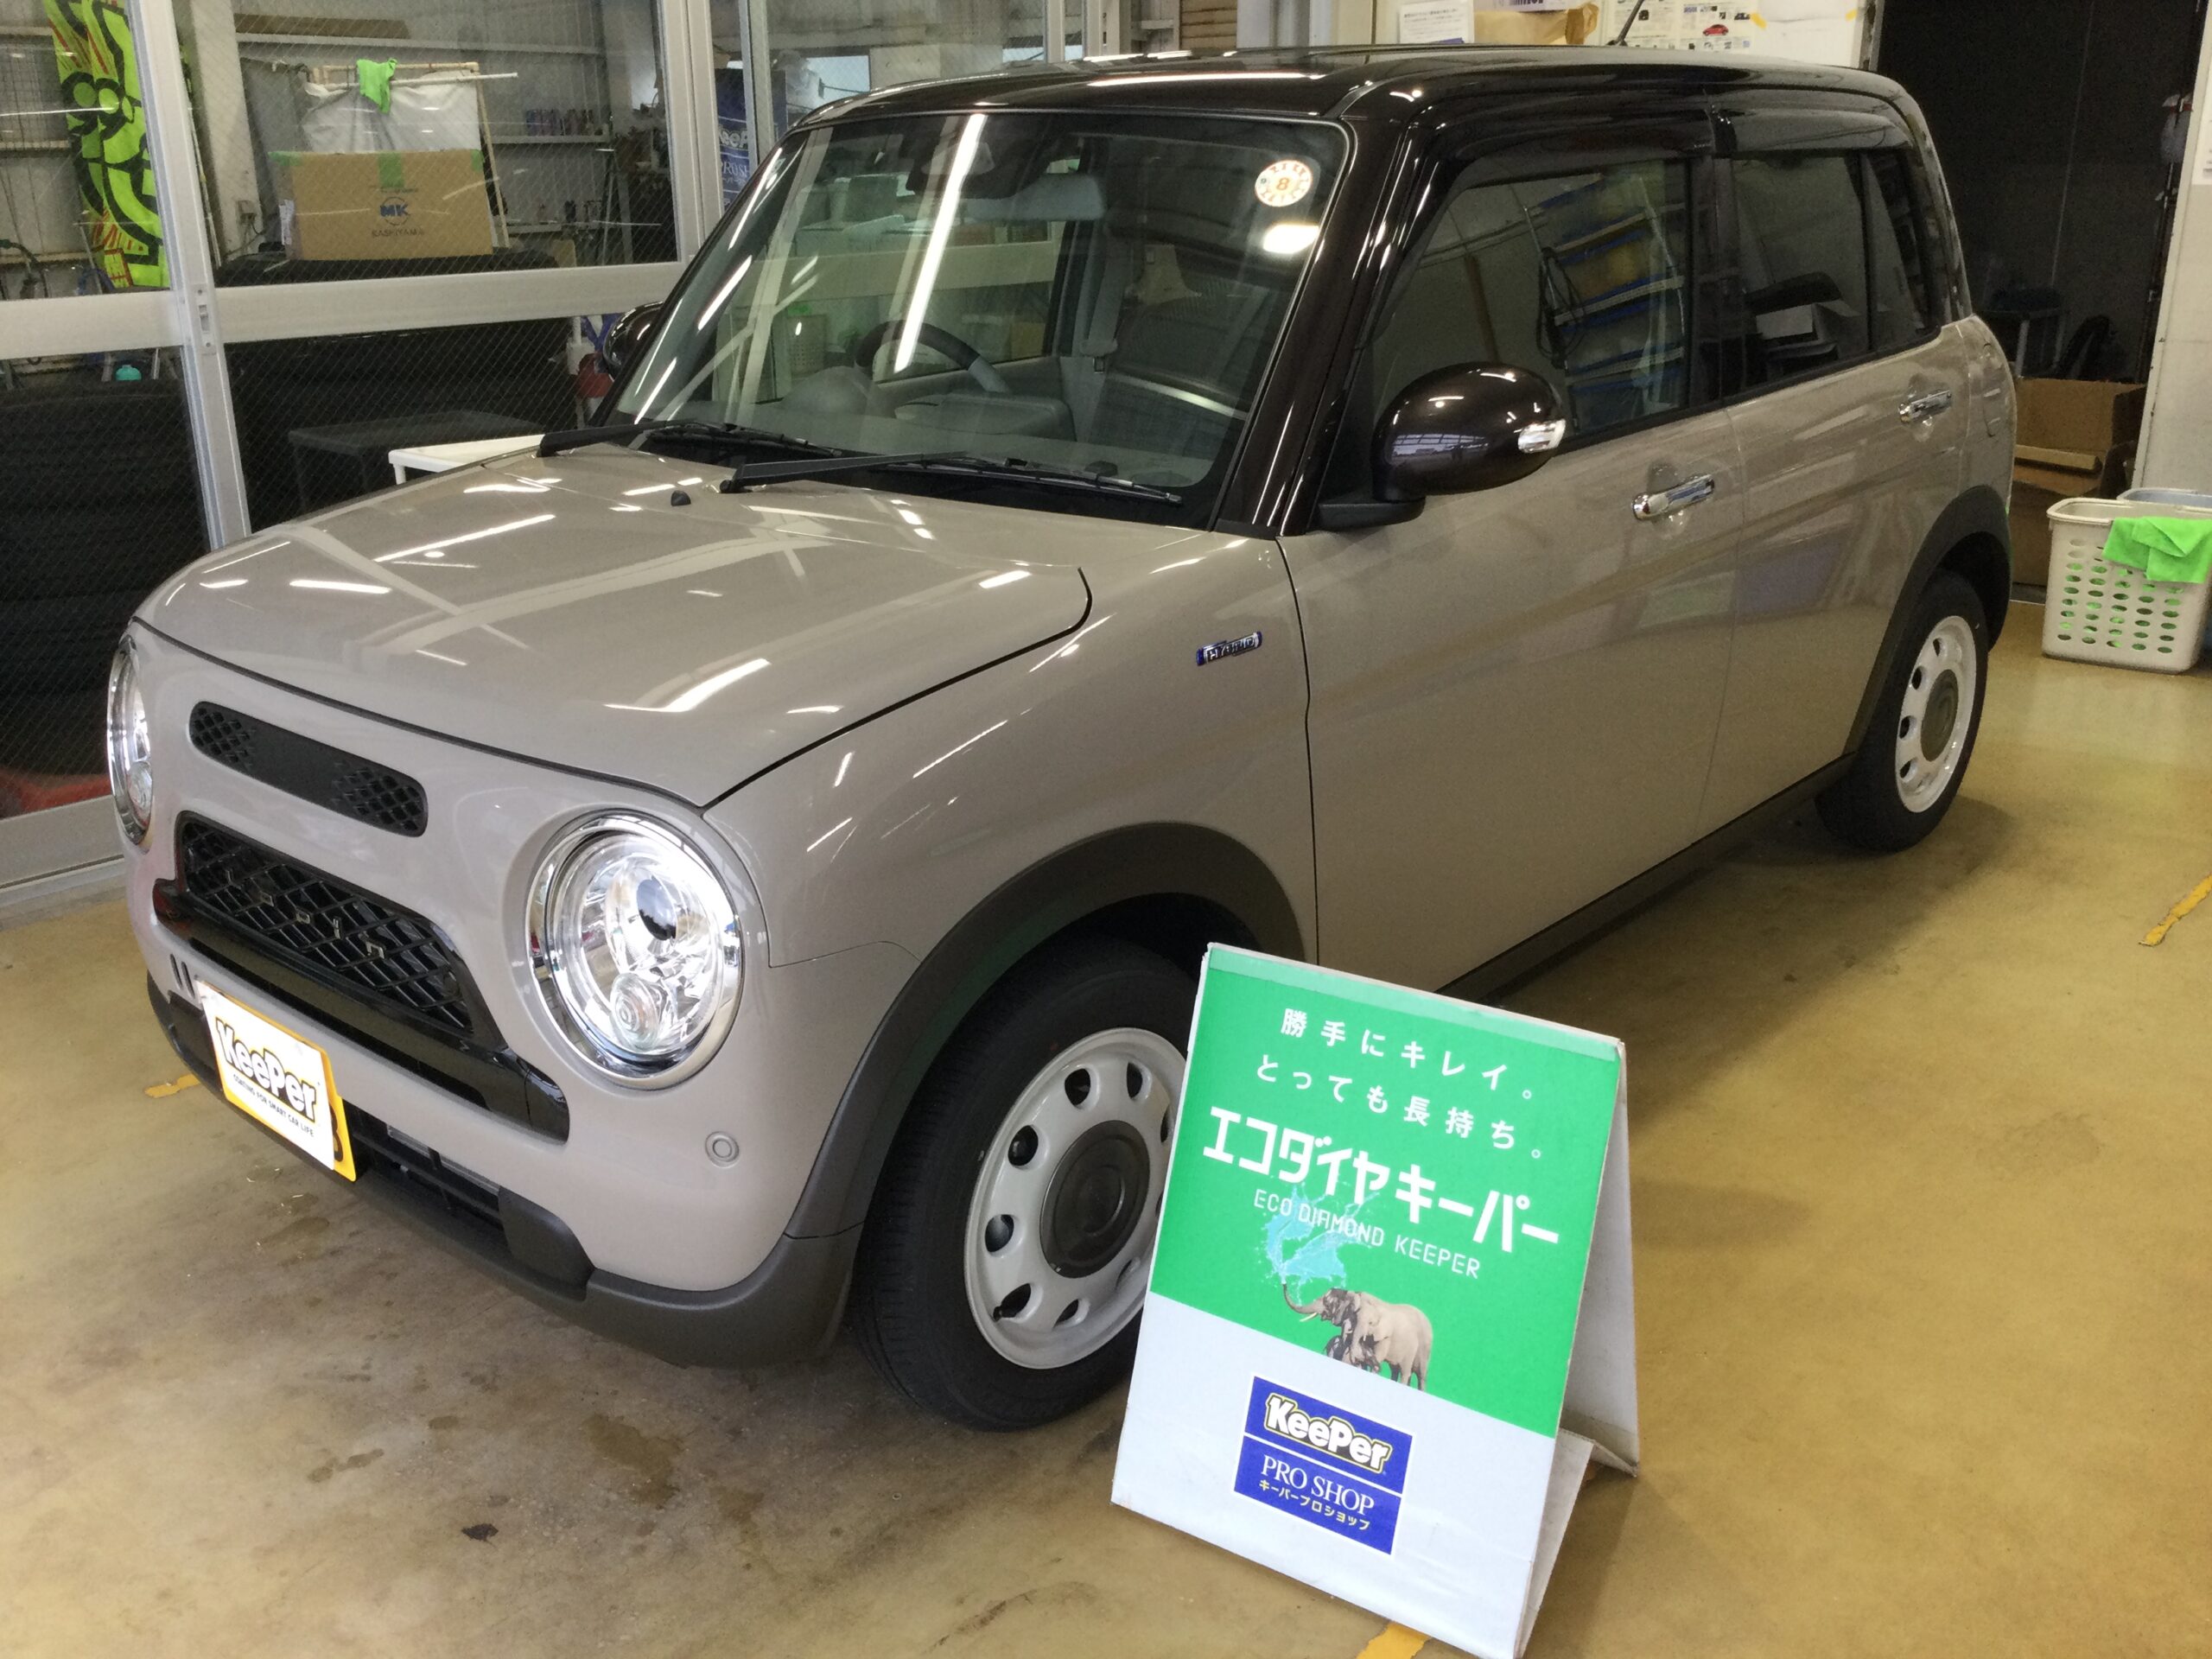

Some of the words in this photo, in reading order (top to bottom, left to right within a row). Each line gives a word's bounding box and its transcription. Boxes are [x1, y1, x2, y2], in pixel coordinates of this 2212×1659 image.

[1276, 177, 1289, 190] 8
[215, 1016, 317, 1123] KeePer
[1281, 1007, 1533, 1099] 勝手にキレイ。
[269, 1100, 286, 1118] SMART
[288, 1114, 299, 1128] CAR
[300, 1122, 315, 1138] LIFE
[1256, 1053, 1542, 1160] とっても長持ち。
[1202, 1105, 1560, 1253] エコダイヤキーパー
[1254, 1188, 1293, 1217] ECO
[1298, 1203, 1385, 1247] DIAMOND
[1394, 1234, 1481, 1280] KEEPER
[1264, 1392, 1393, 1474] KeePer
[1259, 1478, 1370, 1531] キーパープロショップ
[1261, 1454, 1308, 1490] PRO
[1311, 1475, 1375, 1516] SHOP
